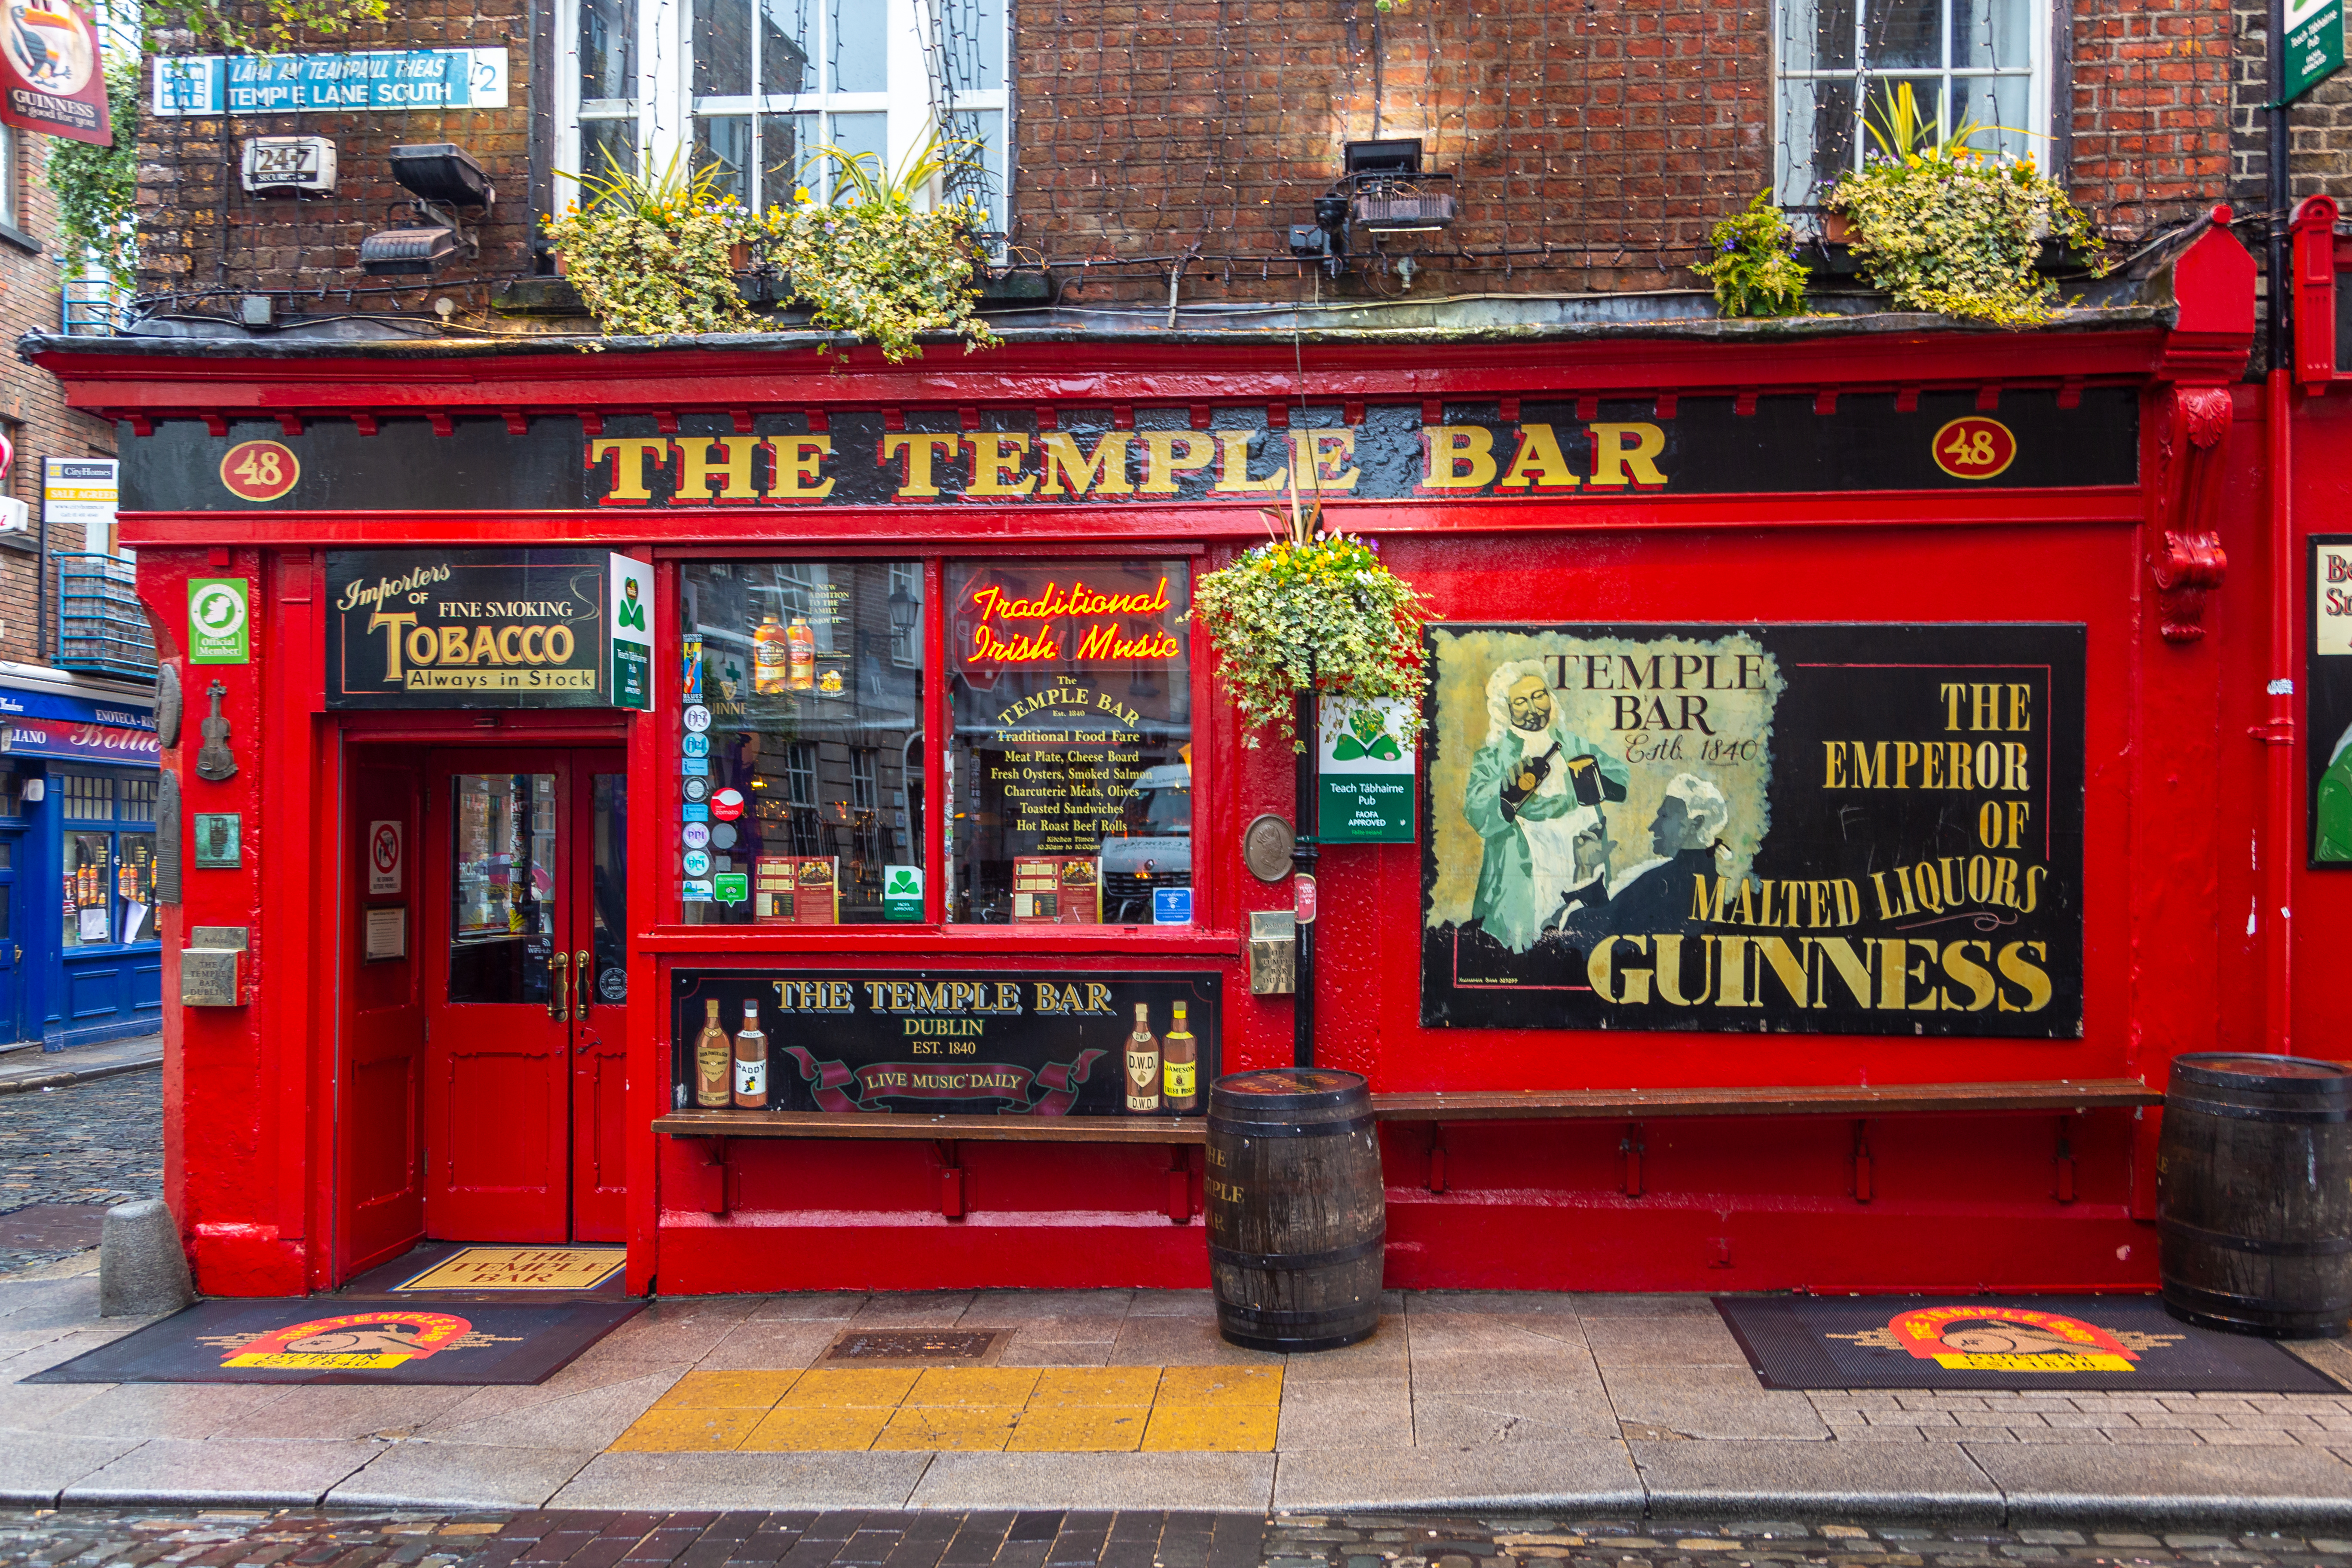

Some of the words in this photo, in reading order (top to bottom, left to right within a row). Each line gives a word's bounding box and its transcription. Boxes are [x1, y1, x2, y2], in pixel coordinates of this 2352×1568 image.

[395, 58, 446, 78] THEAS
[480, 65, 496, 92] 2
[163, 94, 204, 107] BAR
[313, 85, 368, 103] LANE
[378, 83, 451, 102] SOUTH
[12, 89, 95, 118] GUINNESS
[16, 103, 27, 113] is
[28, 106, 55, 118] good
[56, 110, 74, 123] for
[75, 117, 97, 128] you
[1944, 427, 1995, 465] 48
[234, 450, 282, 485] 48
[585, 435, 836, 505] THE
[877, 428, 1360, 502] TEMPLE
[1412, 422, 1668, 495] BAR
[64, 467, 111, 478] CityHomes
[51, 489, 76, 499] SALE
[77, 490, 118, 499] AGREED
[337, 563, 450, 611] Importers
[408, 592, 429, 604] OF
[974, 577, 1170, 621] Traditional
[438, 602, 481, 617] FINE
[486, 601, 574, 618] SMOKING
[201, 637, 235, 646] Official
[367, 612, 575, 683] TOBACCO
[968, 624, 1058, 662] Irish
[1078, 623, 1179, 659] Music
[199, 646, 239, 655] Member
[410, 671, 488, 687] Always
[501, 672, 518, 686] in
[529, 670, 591, 686] Stock
[1057, 675, 1077, 685] The
[1544, 655, 1767, 690] TEMPLE
[997, 687, 1089, 726] TEMPLE
[1096, 692, 1139, 728] BAR
[1611, 695, 1716, 736] BAR
[1941, 683, 2030, 732] THE
[95, 709, 136, 726] ENOTECA
[996, 729, 1069, 742] Traditional
[1075, 729, 1106, 742] Food
[1112, 729, 1140, 742] Fare
[1004, 750, 1031, 762] Meat
[1035, 750, 1064, 764] Plate,
[1068, 750, 1103, 762] Cheese
[1108, 750, 1139, 762] Board
[1625, 735, 1684, 763] Estb.
[1700, 738, 1759, 763] 1840
[1822, 741, 2030, 791] EMPEROR
[991, 768, 1020, 779] Fresh
[1023, 768, 1064, 783] Oysters,
[1068, 768, 1109, 780] Smoked
[1113, 768, 1153, 779] Salmon
[1004, 784, 1066, 797] Charcuterie
[1070, 785, 1104, 799] Meats,
[1108, 784, 1139, 797] Olives
[1330, 782, 1357, 793] Teach
[1359, 782, 1404, 793] Tábhairne
[1020, 802, 1060, 814] Toasted
[1064, 802, 1124, 814] Sandwiches
[1358, 795, 1376, 805] Pub
[1348, 818, 1387, 827] APPROVED
[1355, 810, 1379, 818] FAOFA
[1016, 819, 1037, 831] Hot
[1041, 819, 1069, 831] Roast
[1073, 819, 1097, 831] Beef
[1101, 819, 1127, 831] Rolls
[1979, 800, 2030, 849] OF
[1688, 873, 1861, 928] MALTED
[1870, 854, 2049, 921] LIQUORS
[1587, 934, 2052, 1013] GUINNESS
[772, 980, 855, 1014] THE
[864, 980, 1023, 1015] TEMPLE
[1033, 982, 1117, 1016] BAR
[903, 1018, 984, 1037] DUBLIN
[912, 1041, 943, 1054] EST.
[948, 1041, 976, 1054] 1840
[736, 1061, 766, 1074] PADDY
[1129, 1055, 1155, 1069] D.W.D.
[1164, 1064, 1195, 1073] JAMESON
[867, 1072, 908, 1090] LIVE
[911, 1073, 967, 1089] MUSIC
[970, 1072, 1023, 1090] DAILY
[1165, 1086, 1179, 1094] IRISH
[1133, 1097, 1154, 1109] D.W.D.
[511, 1252, 588, 1261] THE
[450, 1262, 613, 1272] TEMPLE
[469, 1273, 554, 1283] BAR
